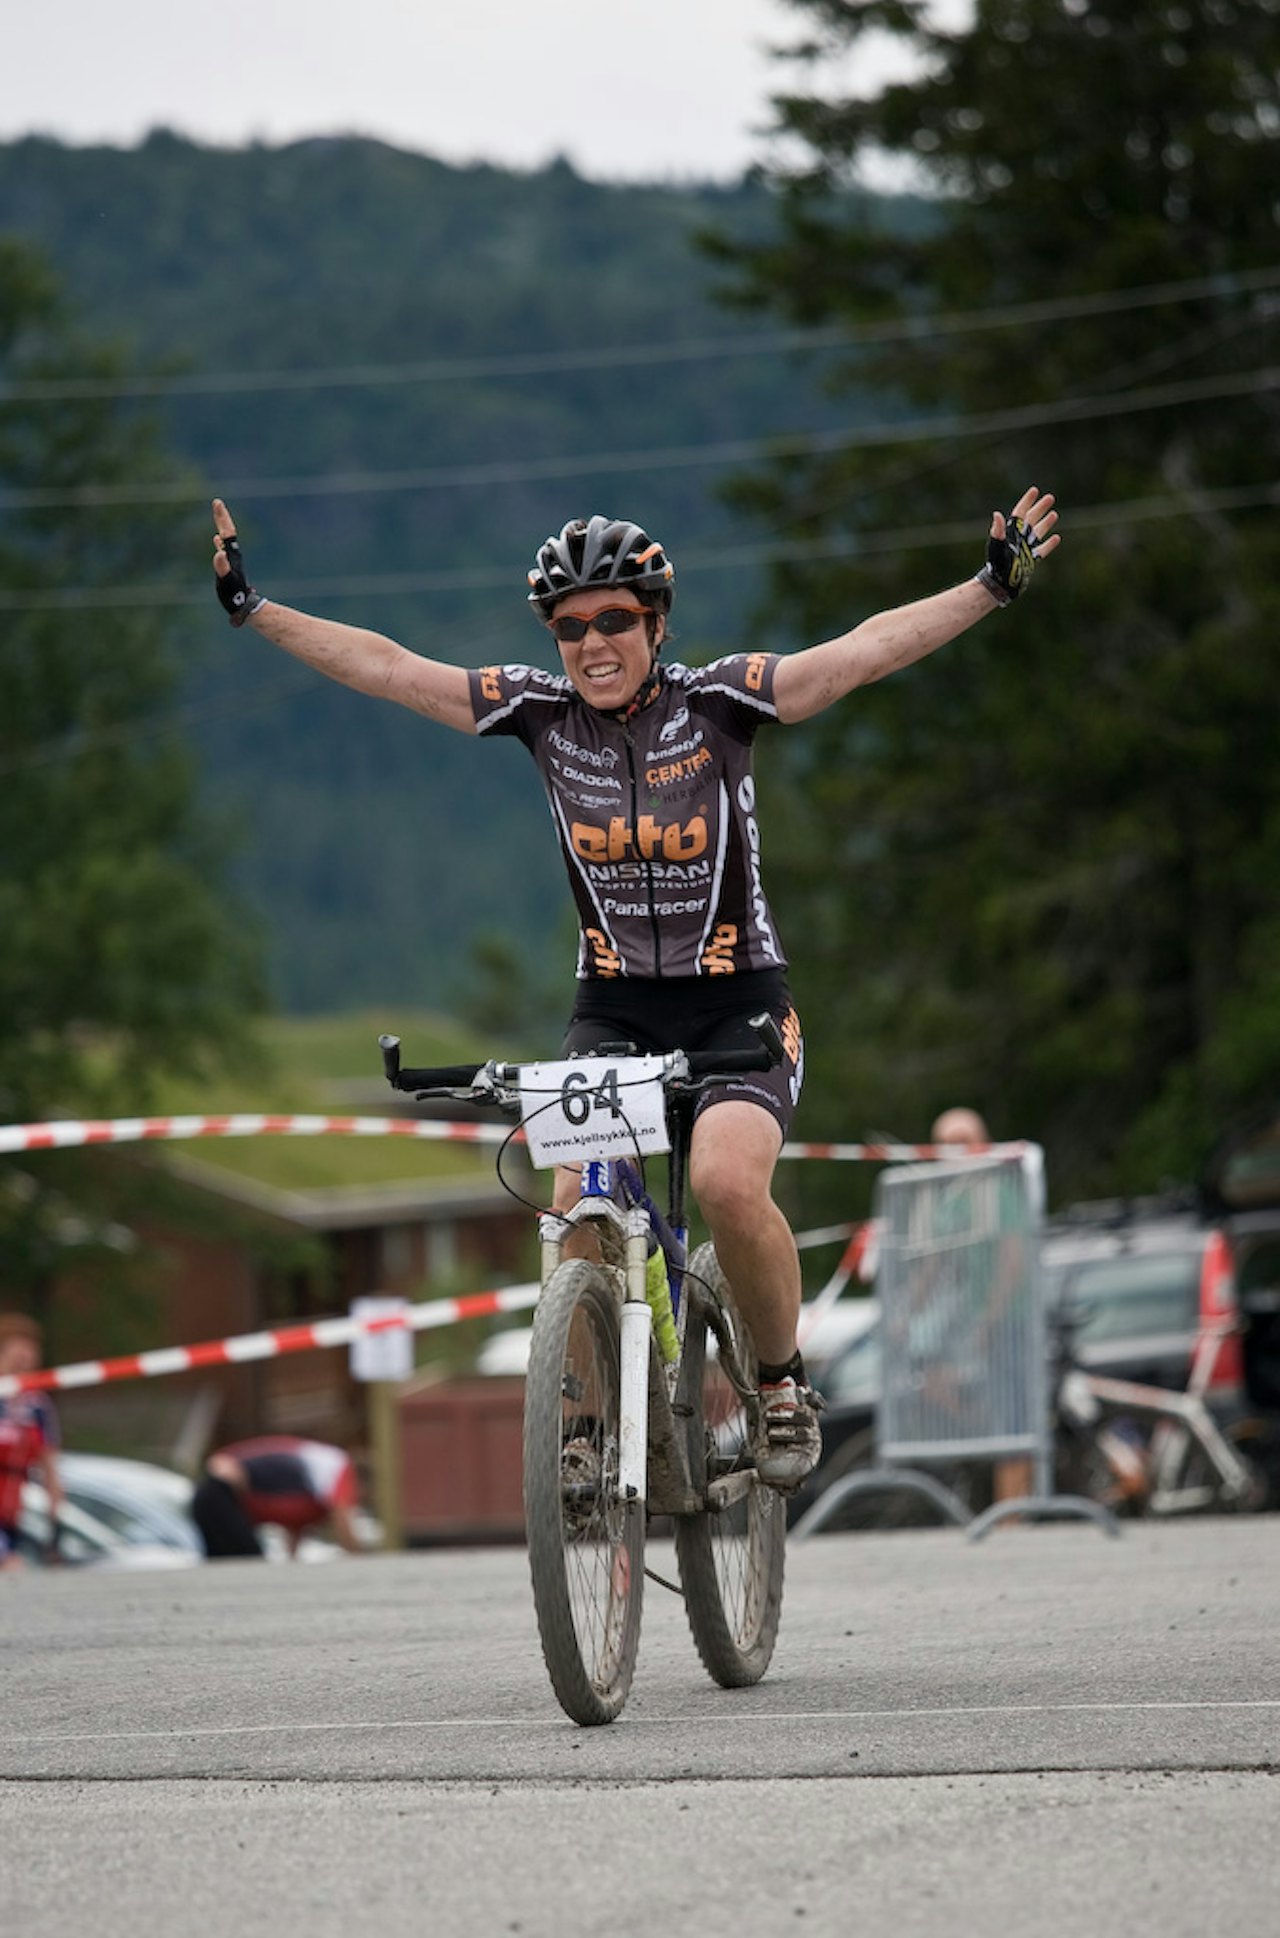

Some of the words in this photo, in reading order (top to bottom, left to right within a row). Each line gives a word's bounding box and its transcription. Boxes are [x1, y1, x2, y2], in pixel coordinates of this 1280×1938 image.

[563, 766, 622, 790] DIADORA
[588, 860, 711, 881] NISSAN
[604, 898, 708, 917] Panaracer
[561, 1069, 623, 1126] 64
